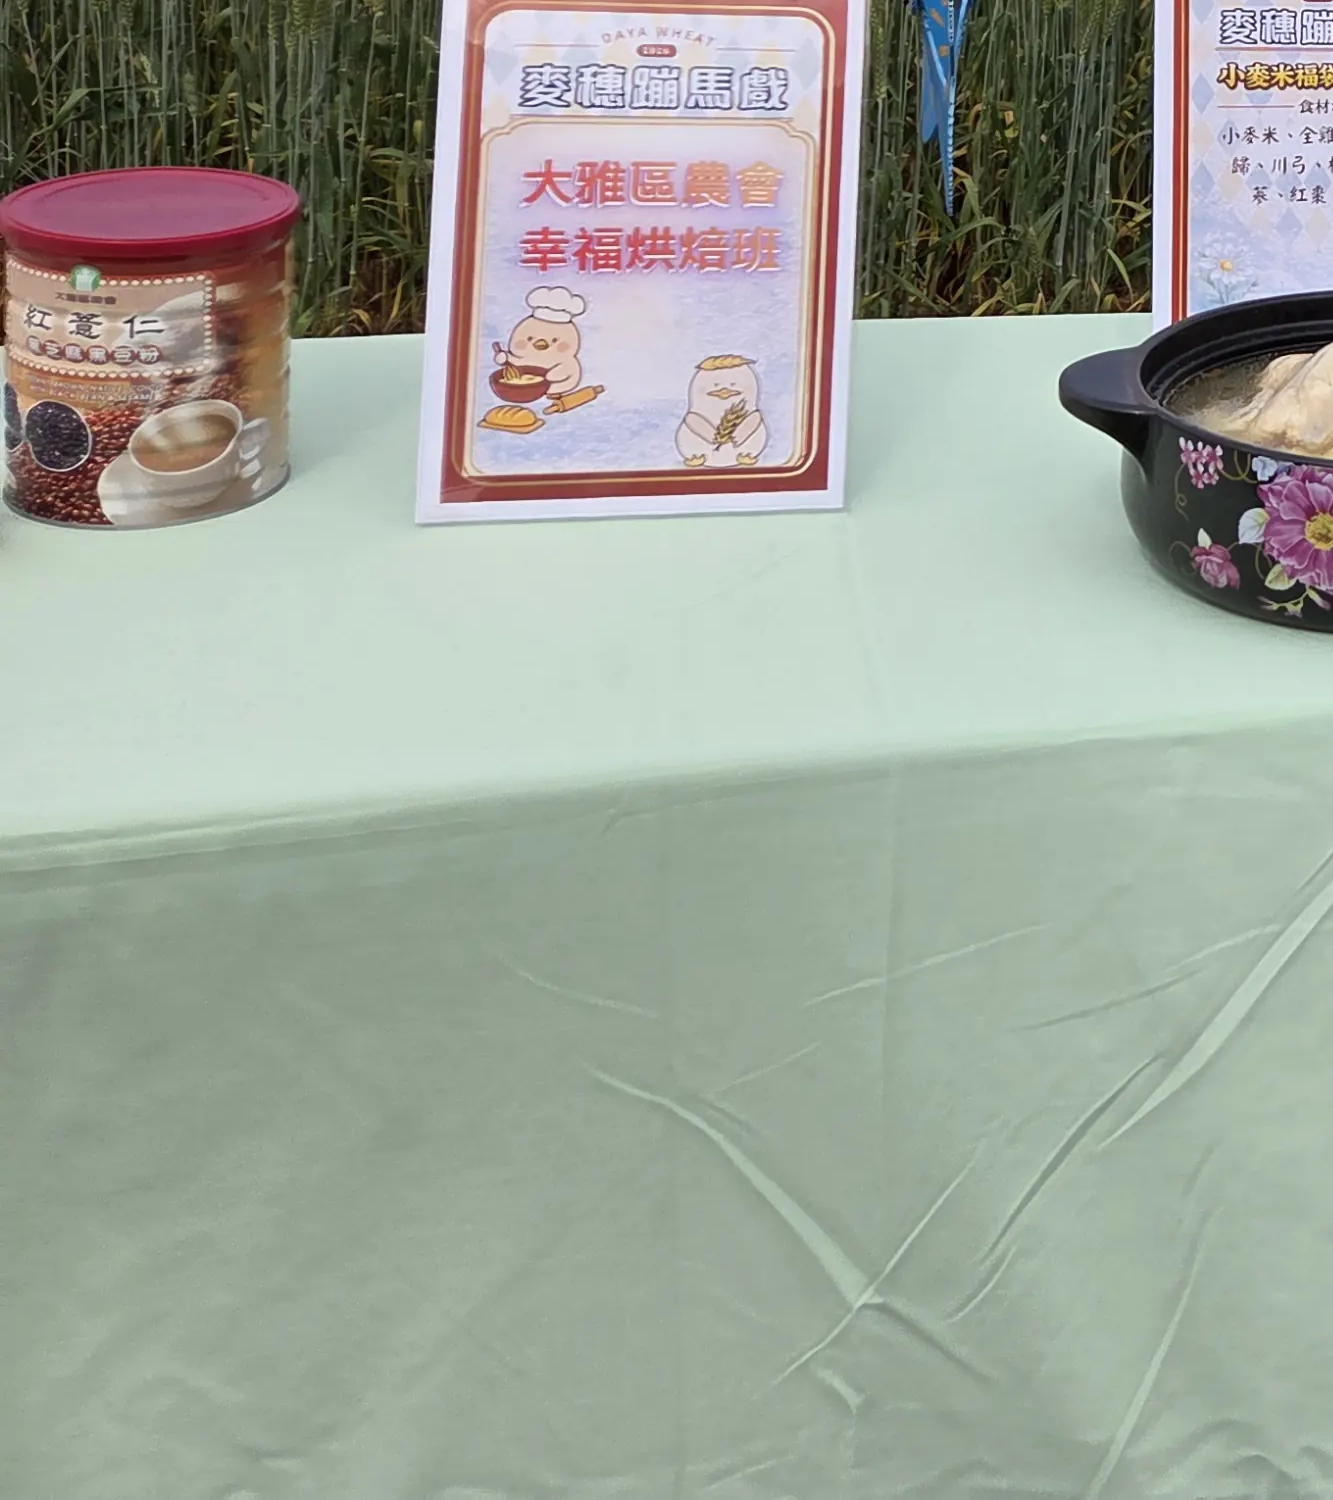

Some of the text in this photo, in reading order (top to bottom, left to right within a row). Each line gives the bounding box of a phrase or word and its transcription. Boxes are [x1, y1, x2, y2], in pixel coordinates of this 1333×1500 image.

[602, 27, 716, 47] DAYA WHEAT
[519, 63, 788, 110] 麥穗蹦馬戲
[522, 159, 785, 207] 大雅區農會
[519, 226, 782, 273] 幸福烘焙班
